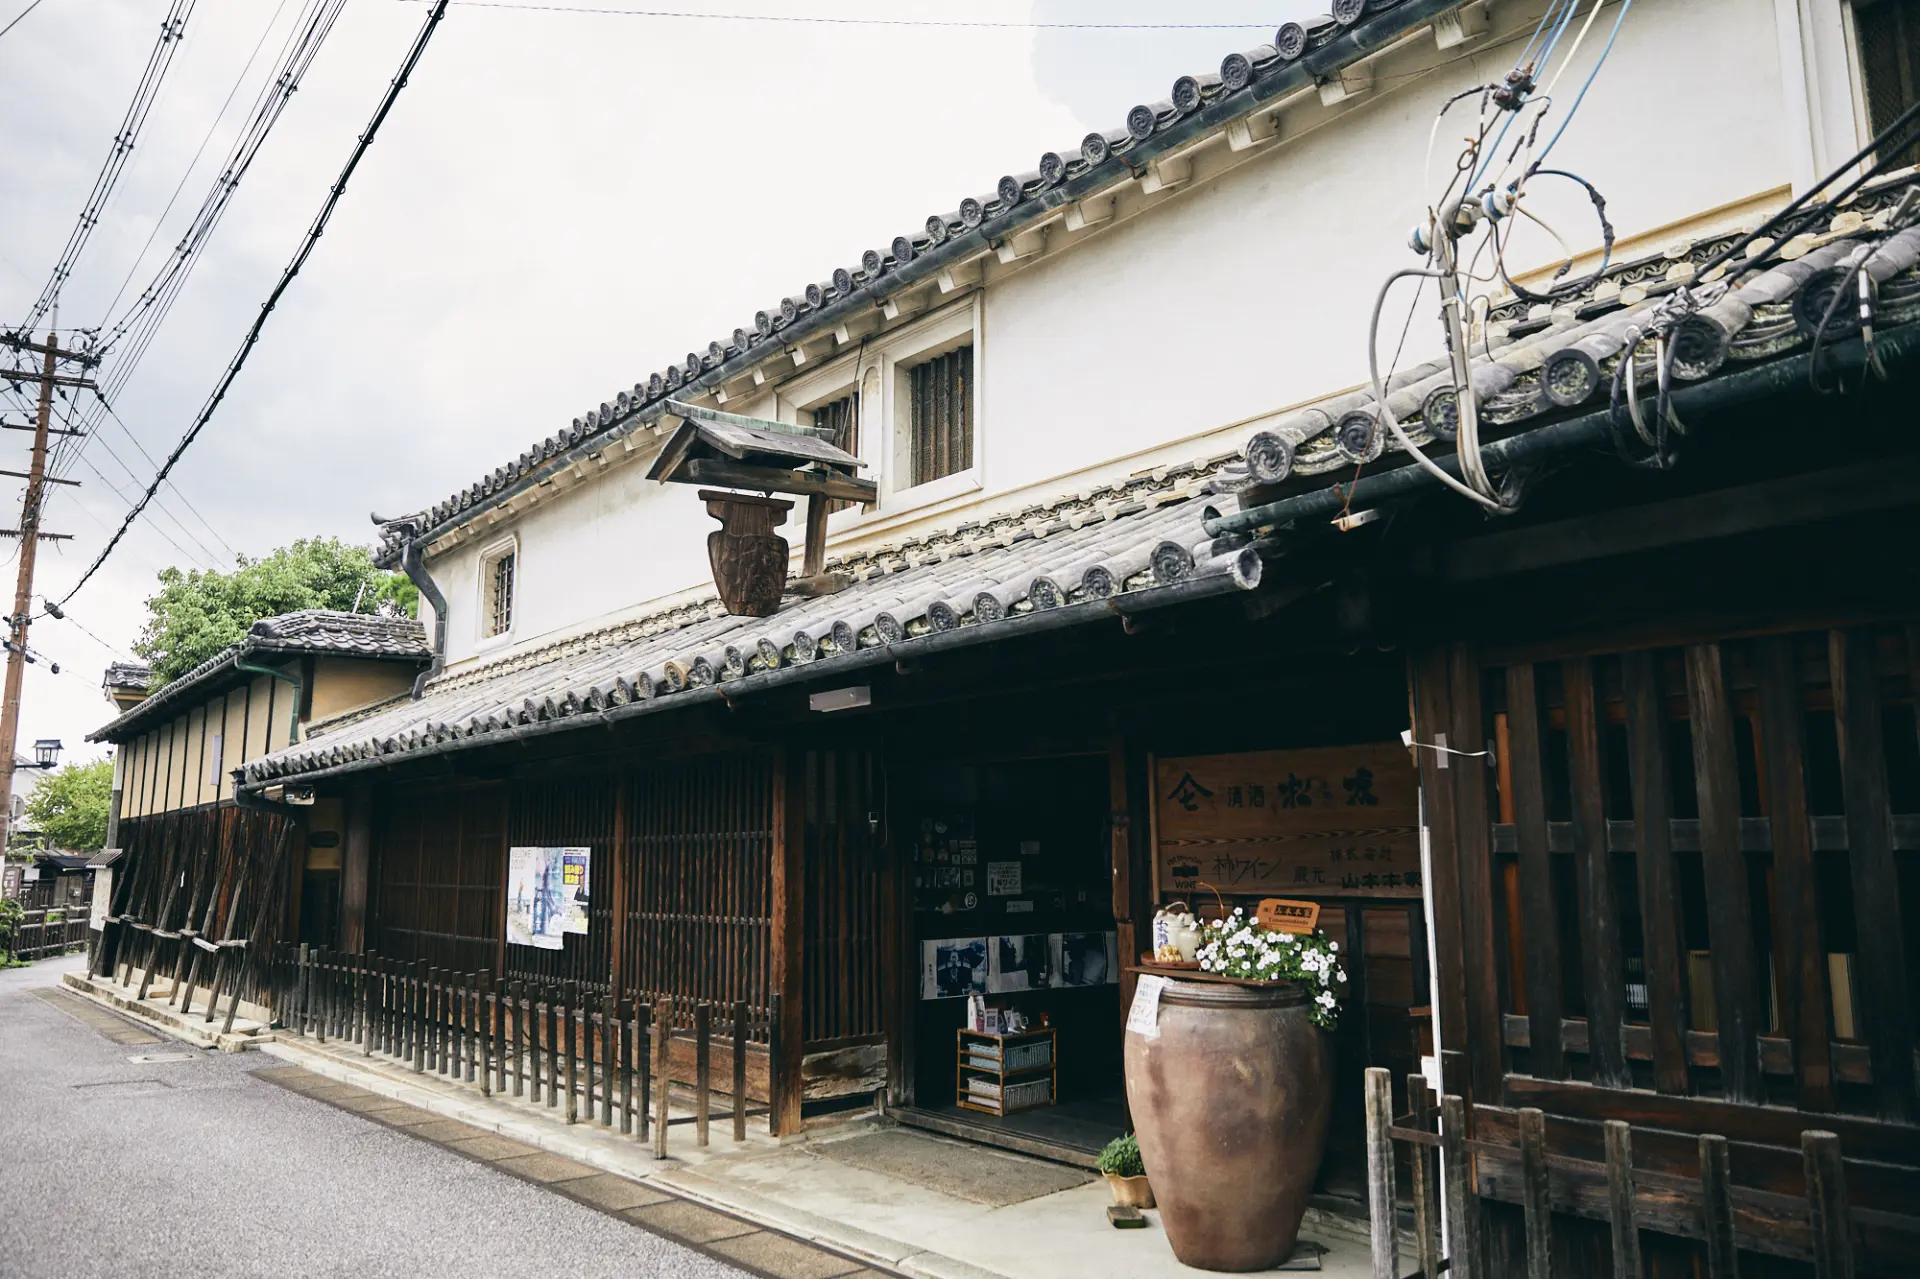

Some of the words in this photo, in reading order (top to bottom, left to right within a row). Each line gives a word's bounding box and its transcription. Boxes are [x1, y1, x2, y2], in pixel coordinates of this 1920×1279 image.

[1228, 784, 1265, 808] 清酒
[1328, 845, 1393, 864] 株式会社
[1341, 870, 1422, 889] 山本本家
